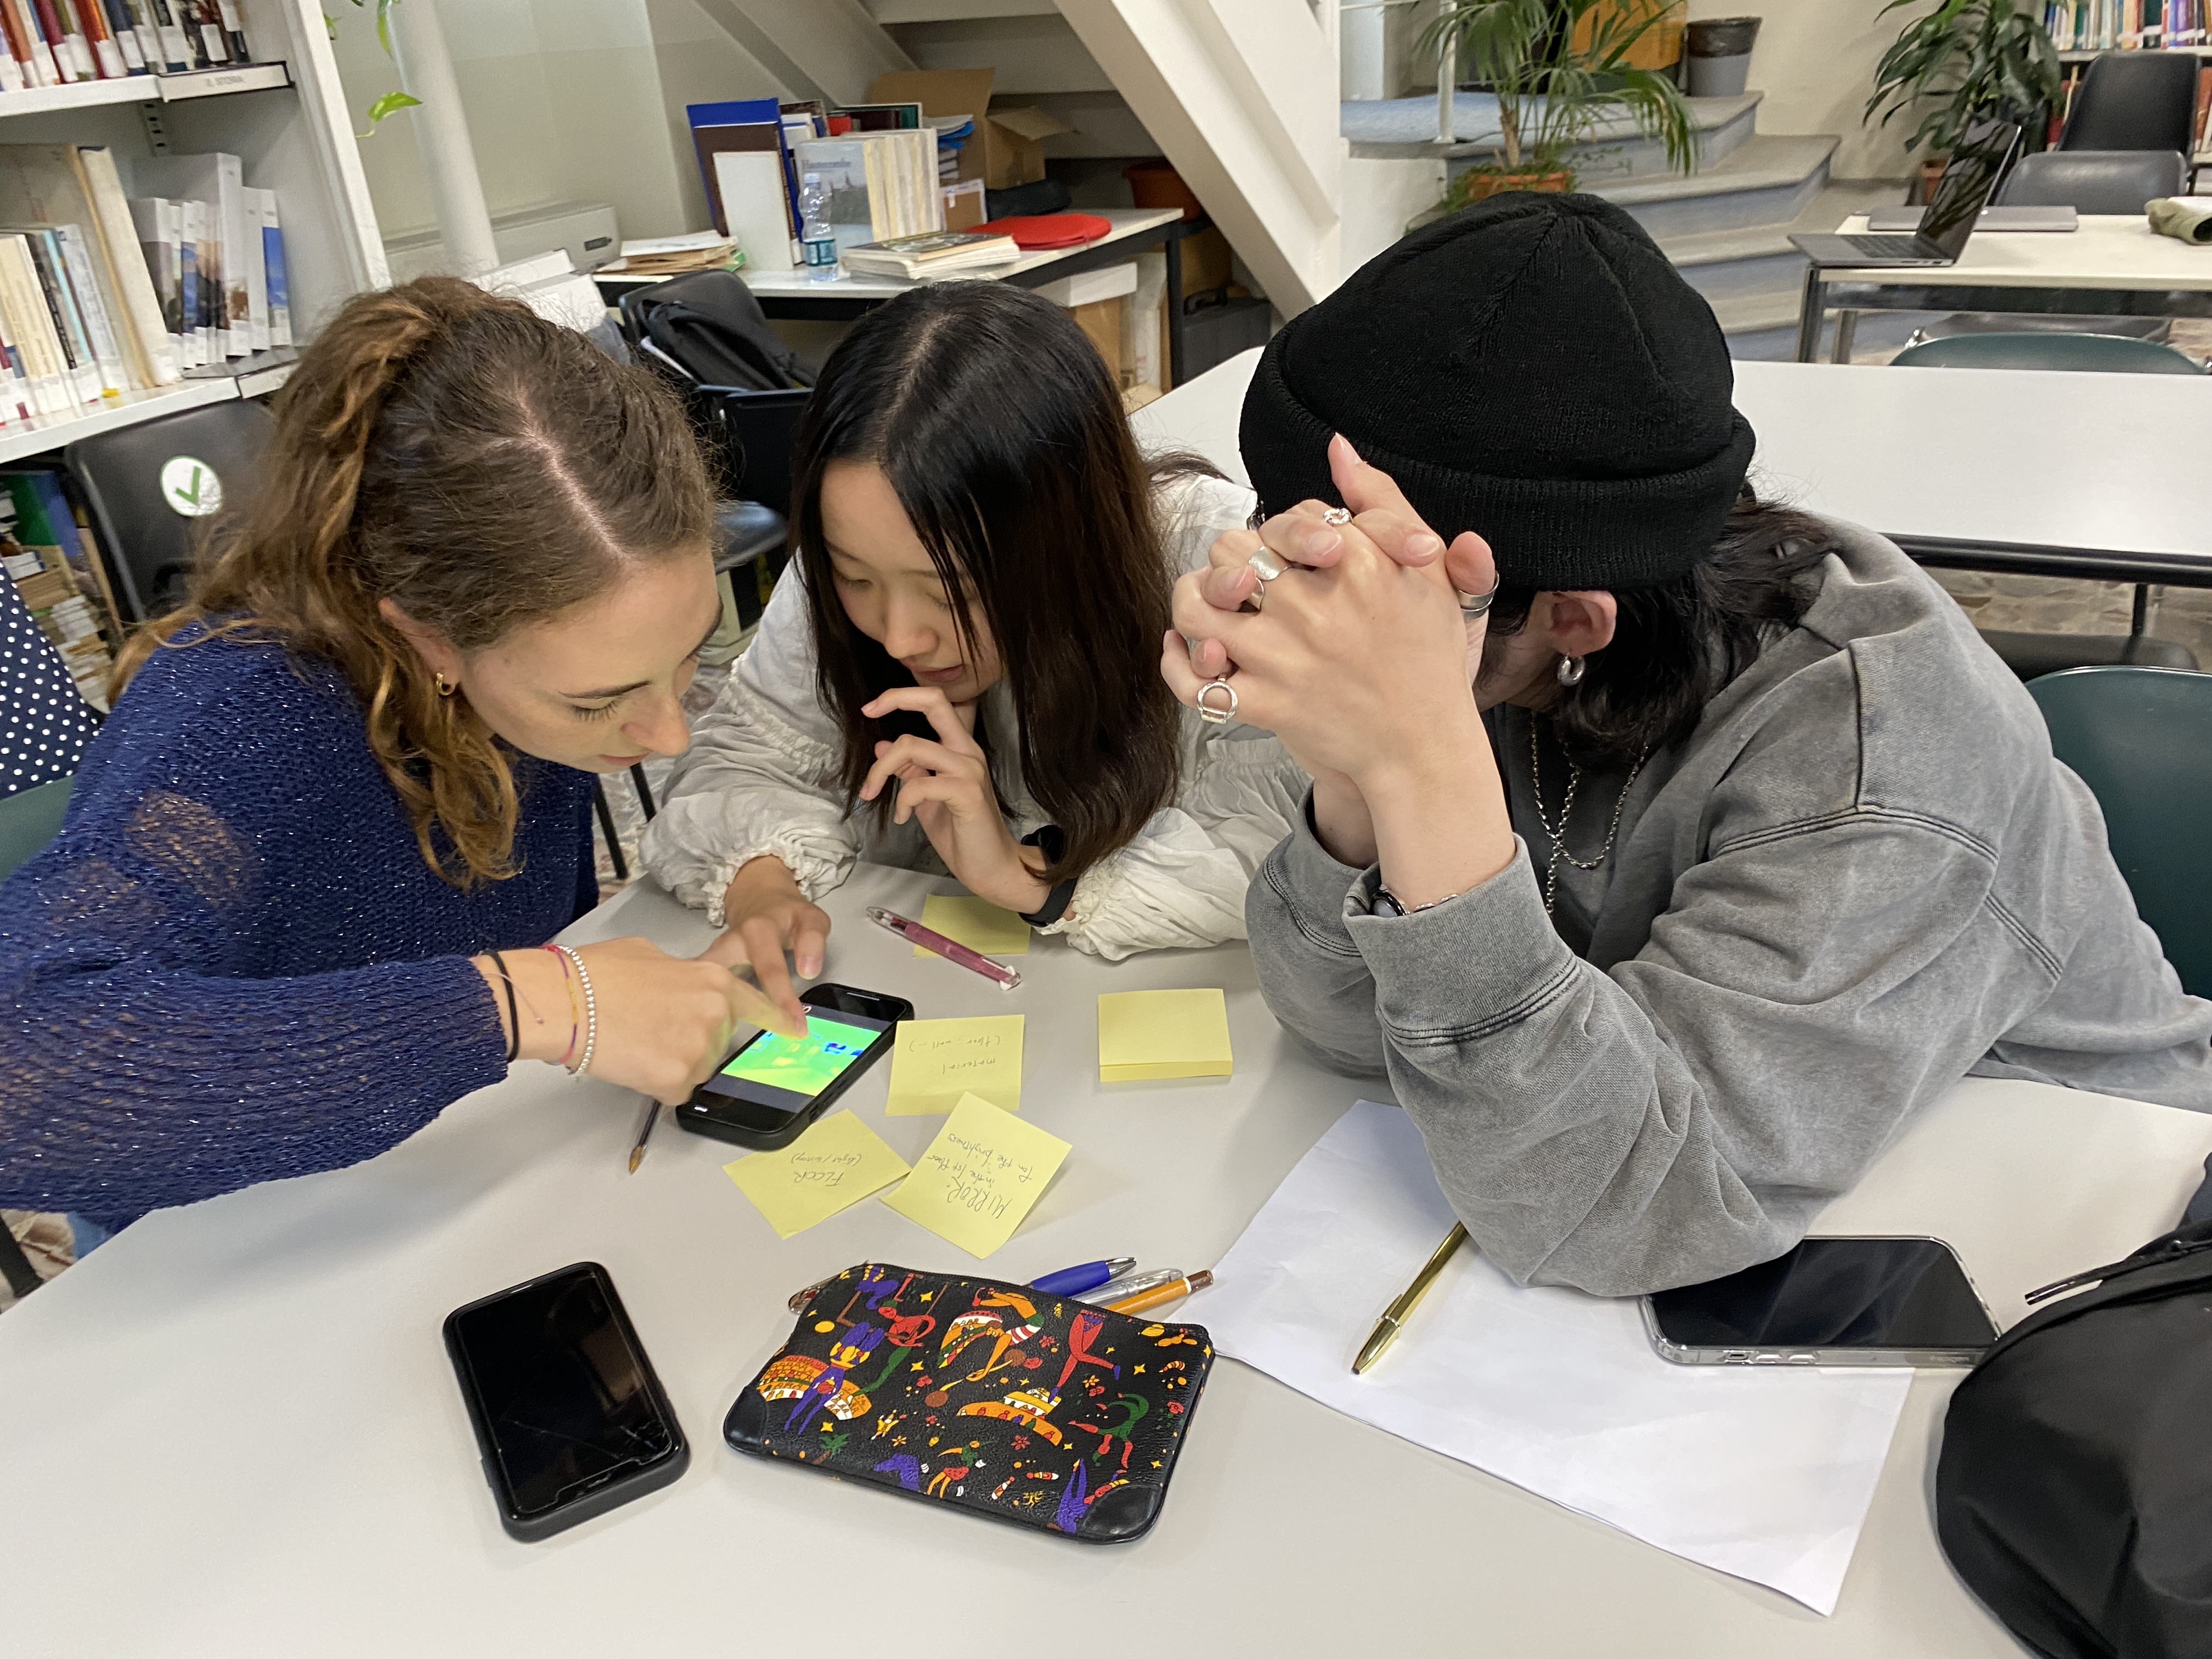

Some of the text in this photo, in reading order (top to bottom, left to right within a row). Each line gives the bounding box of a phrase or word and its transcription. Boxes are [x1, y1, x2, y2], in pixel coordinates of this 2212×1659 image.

[942, 1058, 995, 1075] material
[947, 1133, 994, 1167] brightness
[997, 1155, 1013, 1169] the
[793, 1171, 844, 1186] FLOOR
